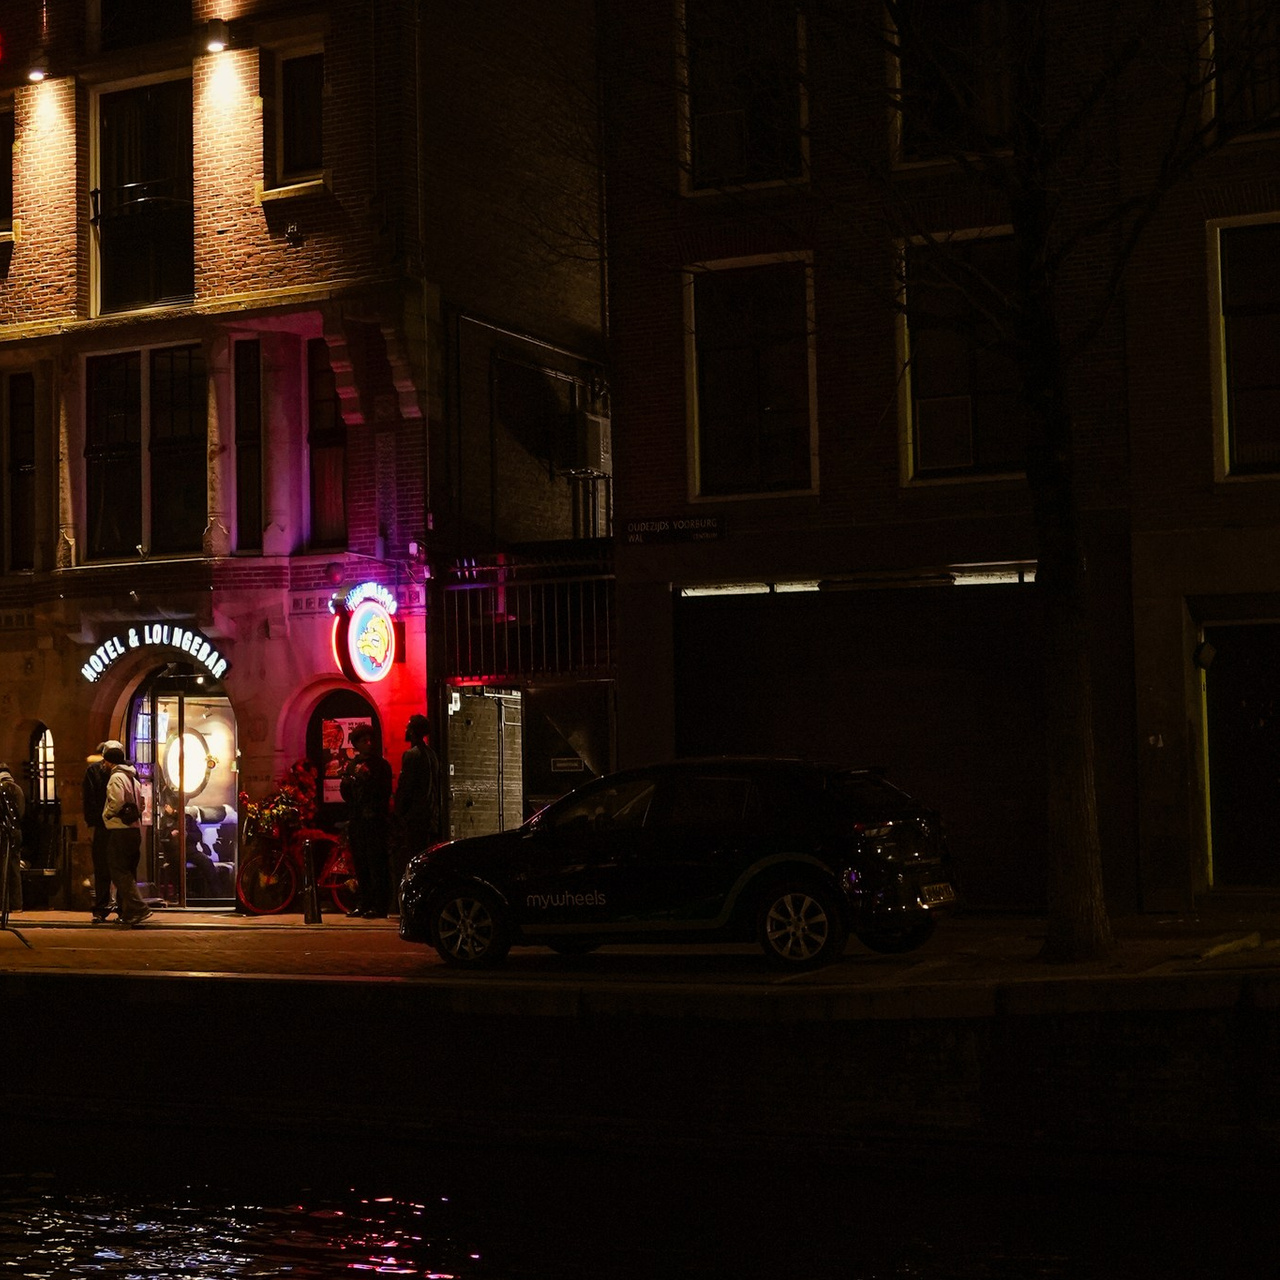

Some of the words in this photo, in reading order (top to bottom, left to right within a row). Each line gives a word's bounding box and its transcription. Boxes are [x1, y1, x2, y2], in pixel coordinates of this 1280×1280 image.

[627, 521, 670, 533] OUDEZIJDS
[672, 518, 717, 530] VOORBURG
[81, 636, 125, 682] HOTEL
[128, 628, 140, 648] &
[144, 624, 227, 679] LOUNGEBAR
[526, 889, 607, 910] mywheels
